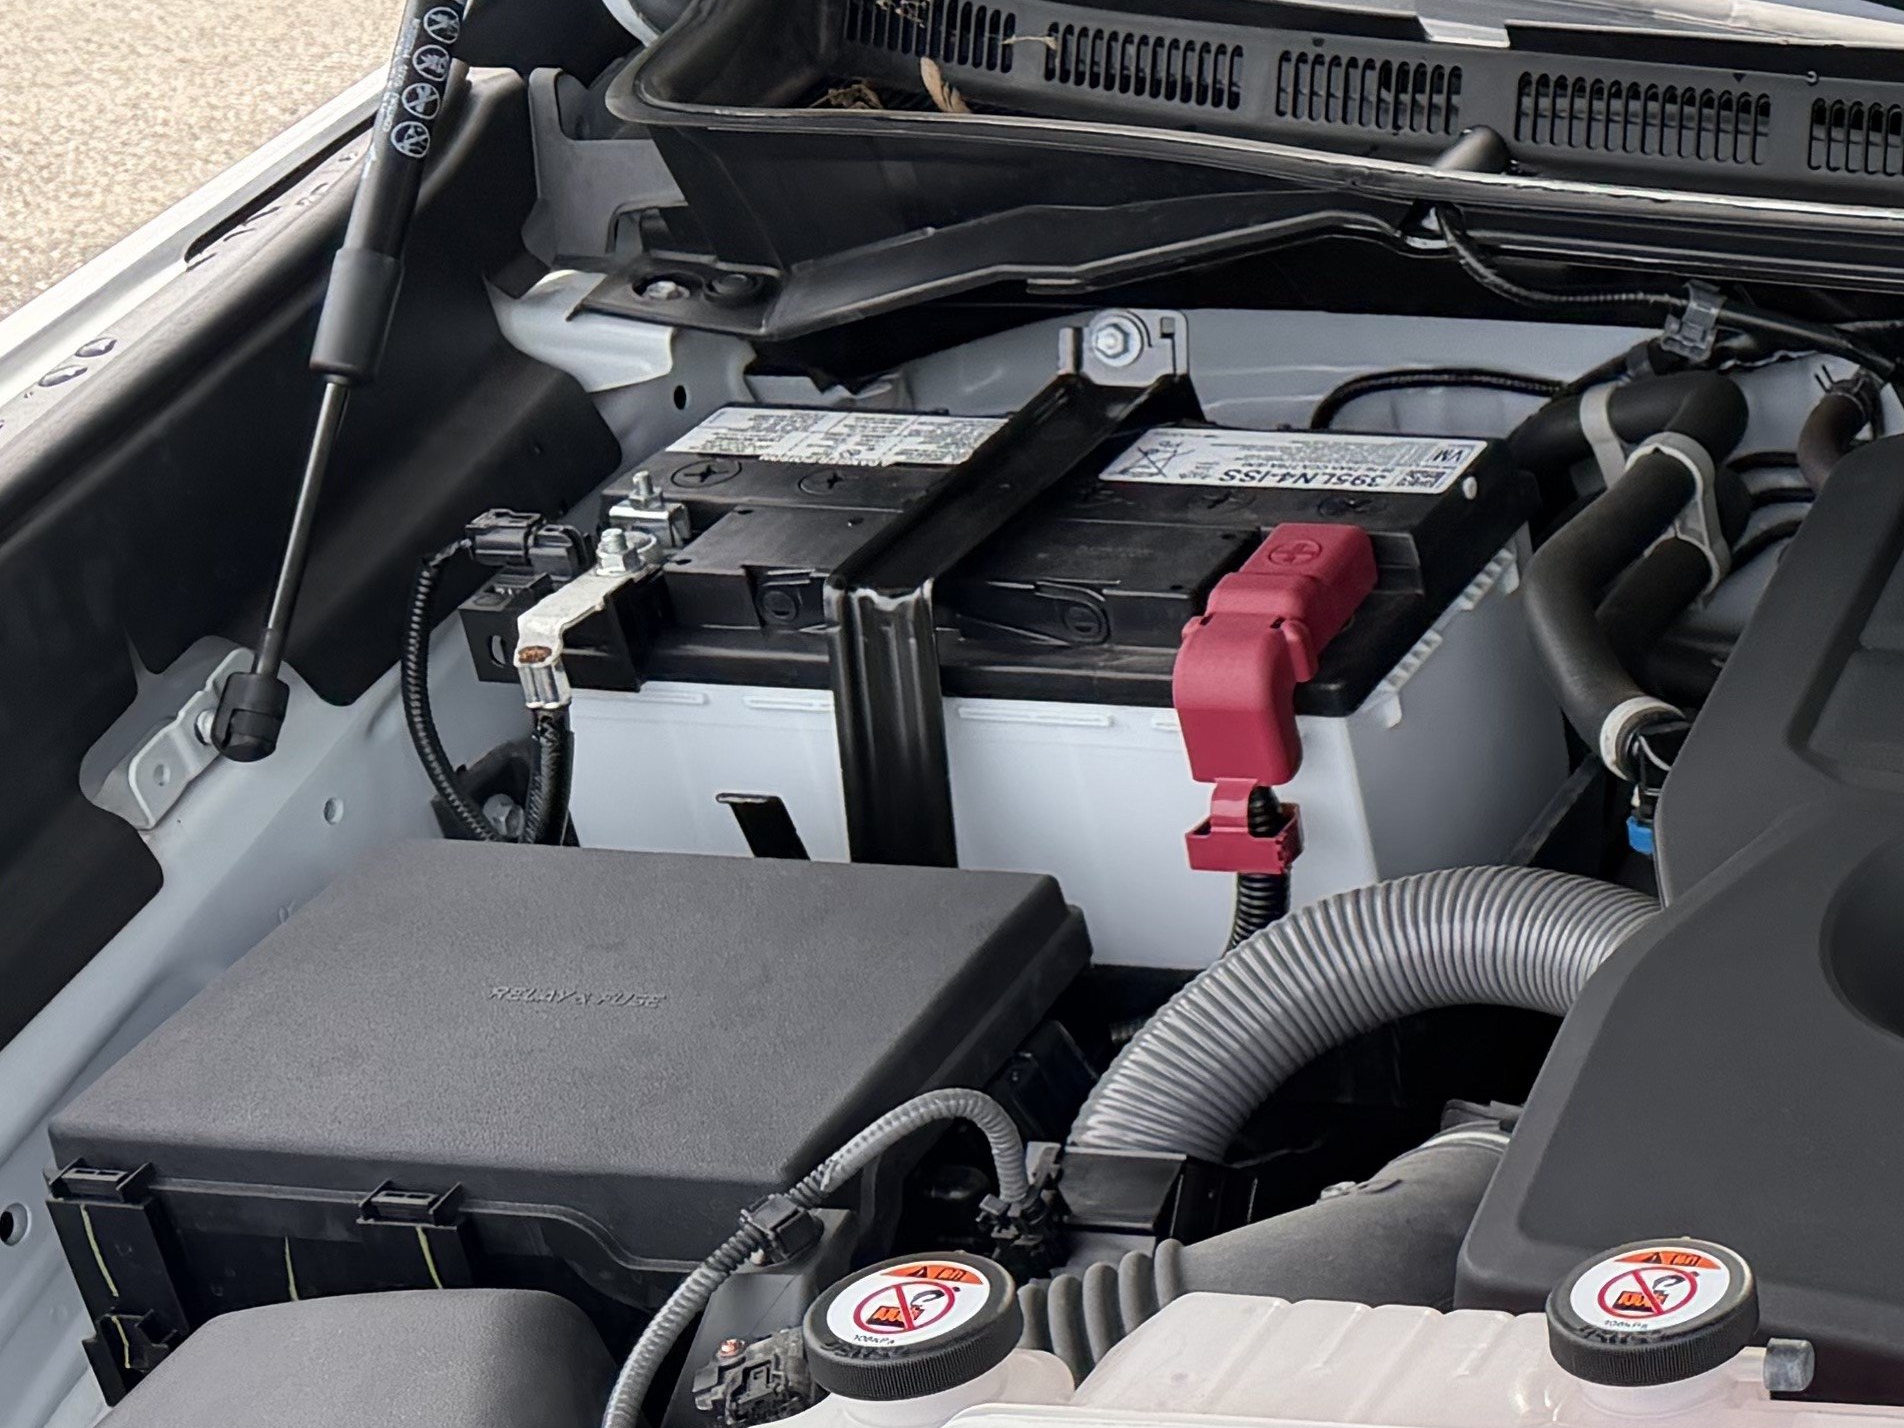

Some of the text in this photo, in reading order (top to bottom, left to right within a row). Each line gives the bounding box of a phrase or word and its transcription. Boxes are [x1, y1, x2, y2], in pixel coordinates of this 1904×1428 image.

[1433, 449, 1465, 464] VM
[1218, 468, 1388, 489] 395LN4-ISS
[488, 985, 577, 1003] RELAY
[597, 992, 668, 1009] FUSE
